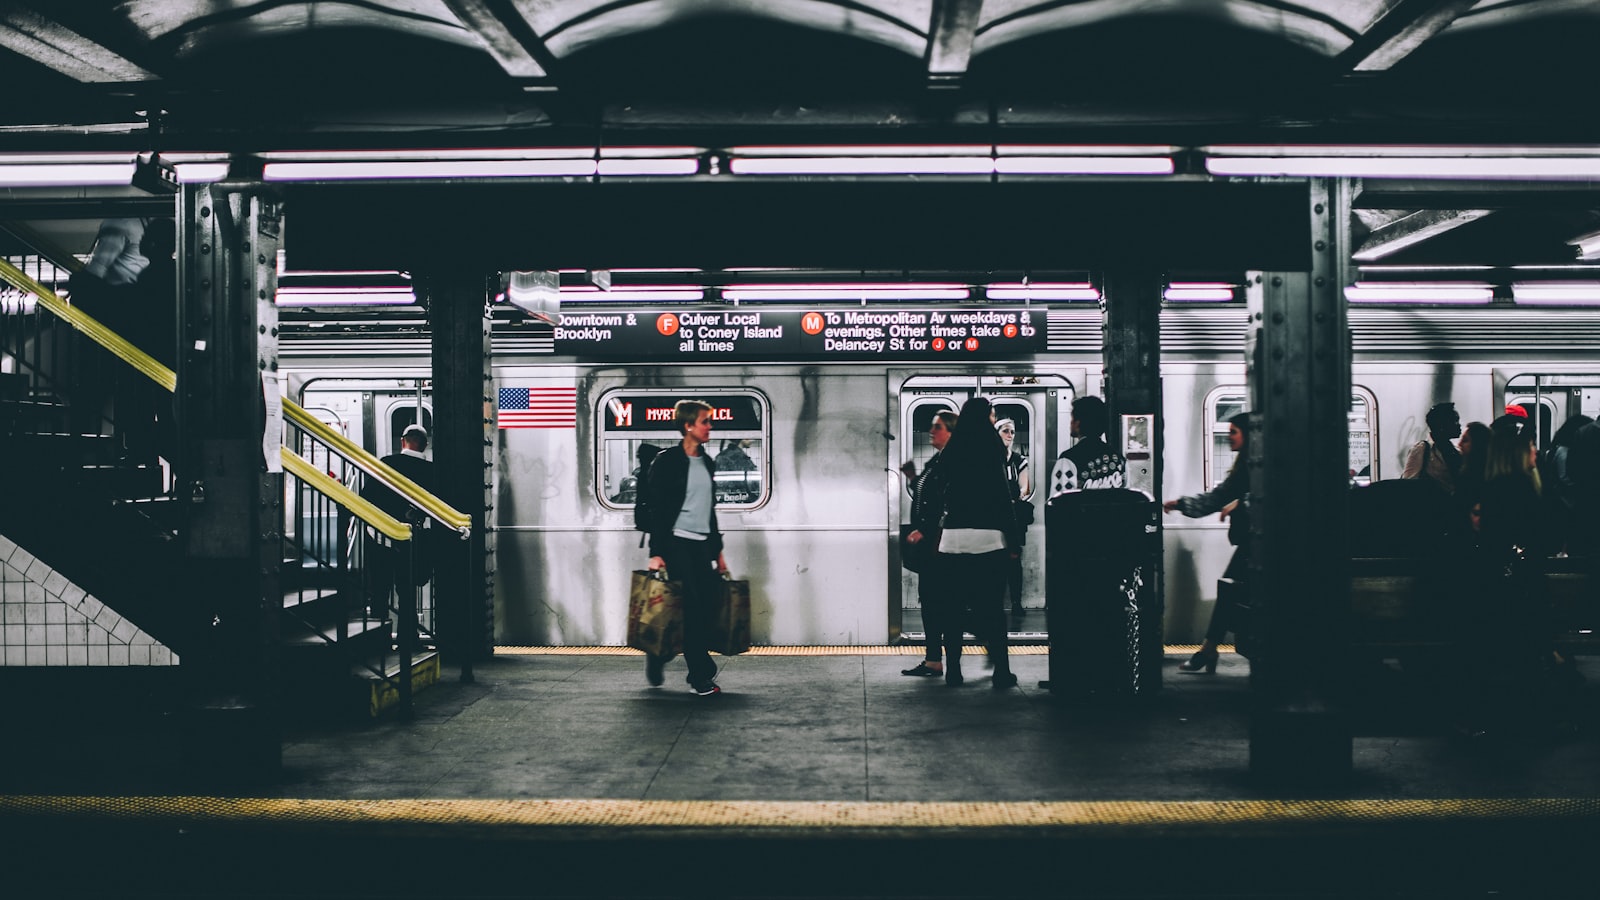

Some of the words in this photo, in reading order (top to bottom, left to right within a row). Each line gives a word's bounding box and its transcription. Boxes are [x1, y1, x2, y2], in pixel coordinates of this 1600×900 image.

[557, 313, 622, 326] Downtown
[627, 313, 637, 326] &
[679, 313, 720, 326] Culver
[724, 313, 760, 326] Local
[824, 312, 840, 325] To
[845, 312, 926, 327] Metropolitan
[930, 312, 946, 325] Av
[950, 312, 1016, 327] weekdays
[1020, 312, 1031, 325] &
[554, 327, 611, 341] Brooklyn
[679, 327, 694, 339] to
[698, 327, 740, 341] Coney
[744, 326, 782, 339] Island
[825, 326, 885, 340] evenings.
[890, 325, 926, 338] Other
[931, 325, 966, 338] times
[971, 325, 1001, 338] take
[1020, 325, 1036, 338] to
[680, 339, 694, 352] all
[698, 339, 735, 352] times
[825, 338, 885, 353] Delancey
[890, 338, 904, 351] St
[909, 338, 928, 351] for
[948, 341, 962, 351] or
[614, 402, 633, 426] M
[645, 408, 677, 420] MYRT
[712, 408, 733, 420] LCL
